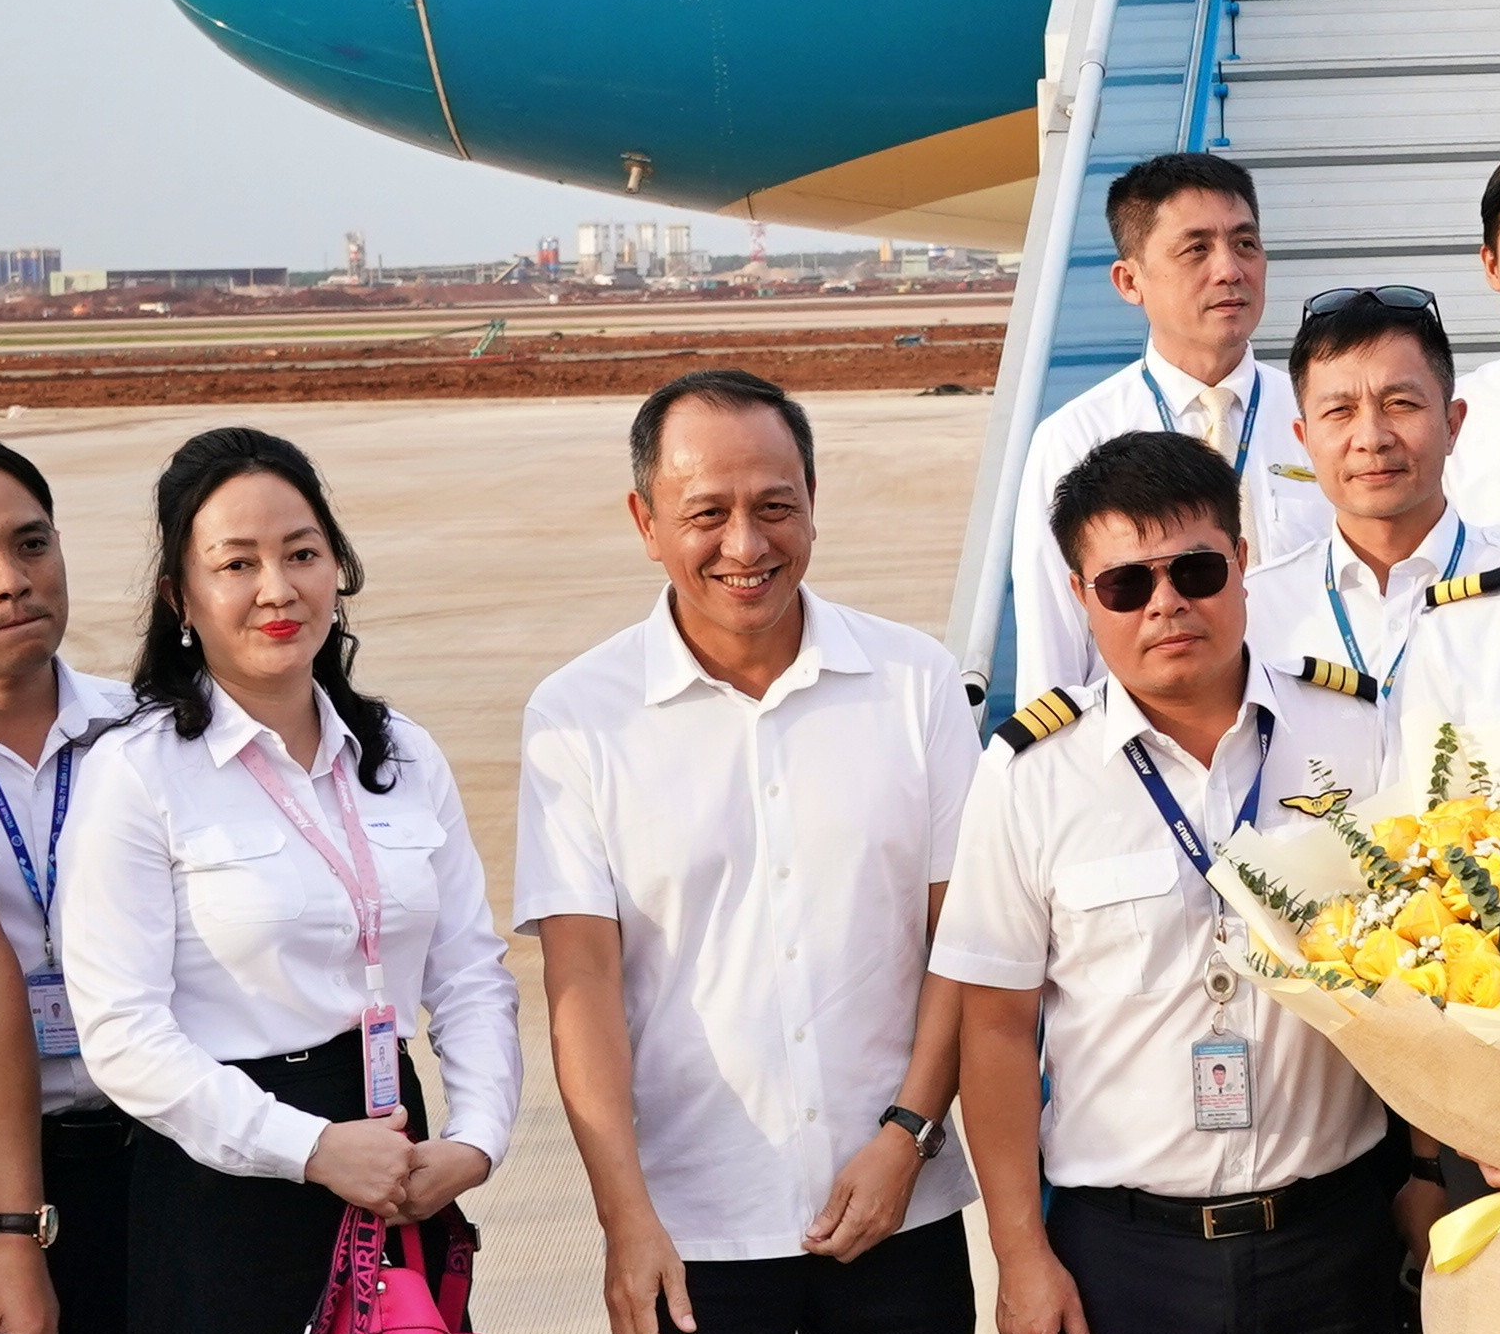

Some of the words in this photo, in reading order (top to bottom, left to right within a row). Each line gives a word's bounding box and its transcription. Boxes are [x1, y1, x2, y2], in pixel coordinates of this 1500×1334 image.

[1125, 740, 1152, 775] AIRBUS
[1174, 820, 1202, 857] AIRBUS
[356, 1233, 378, 1303] KARL
